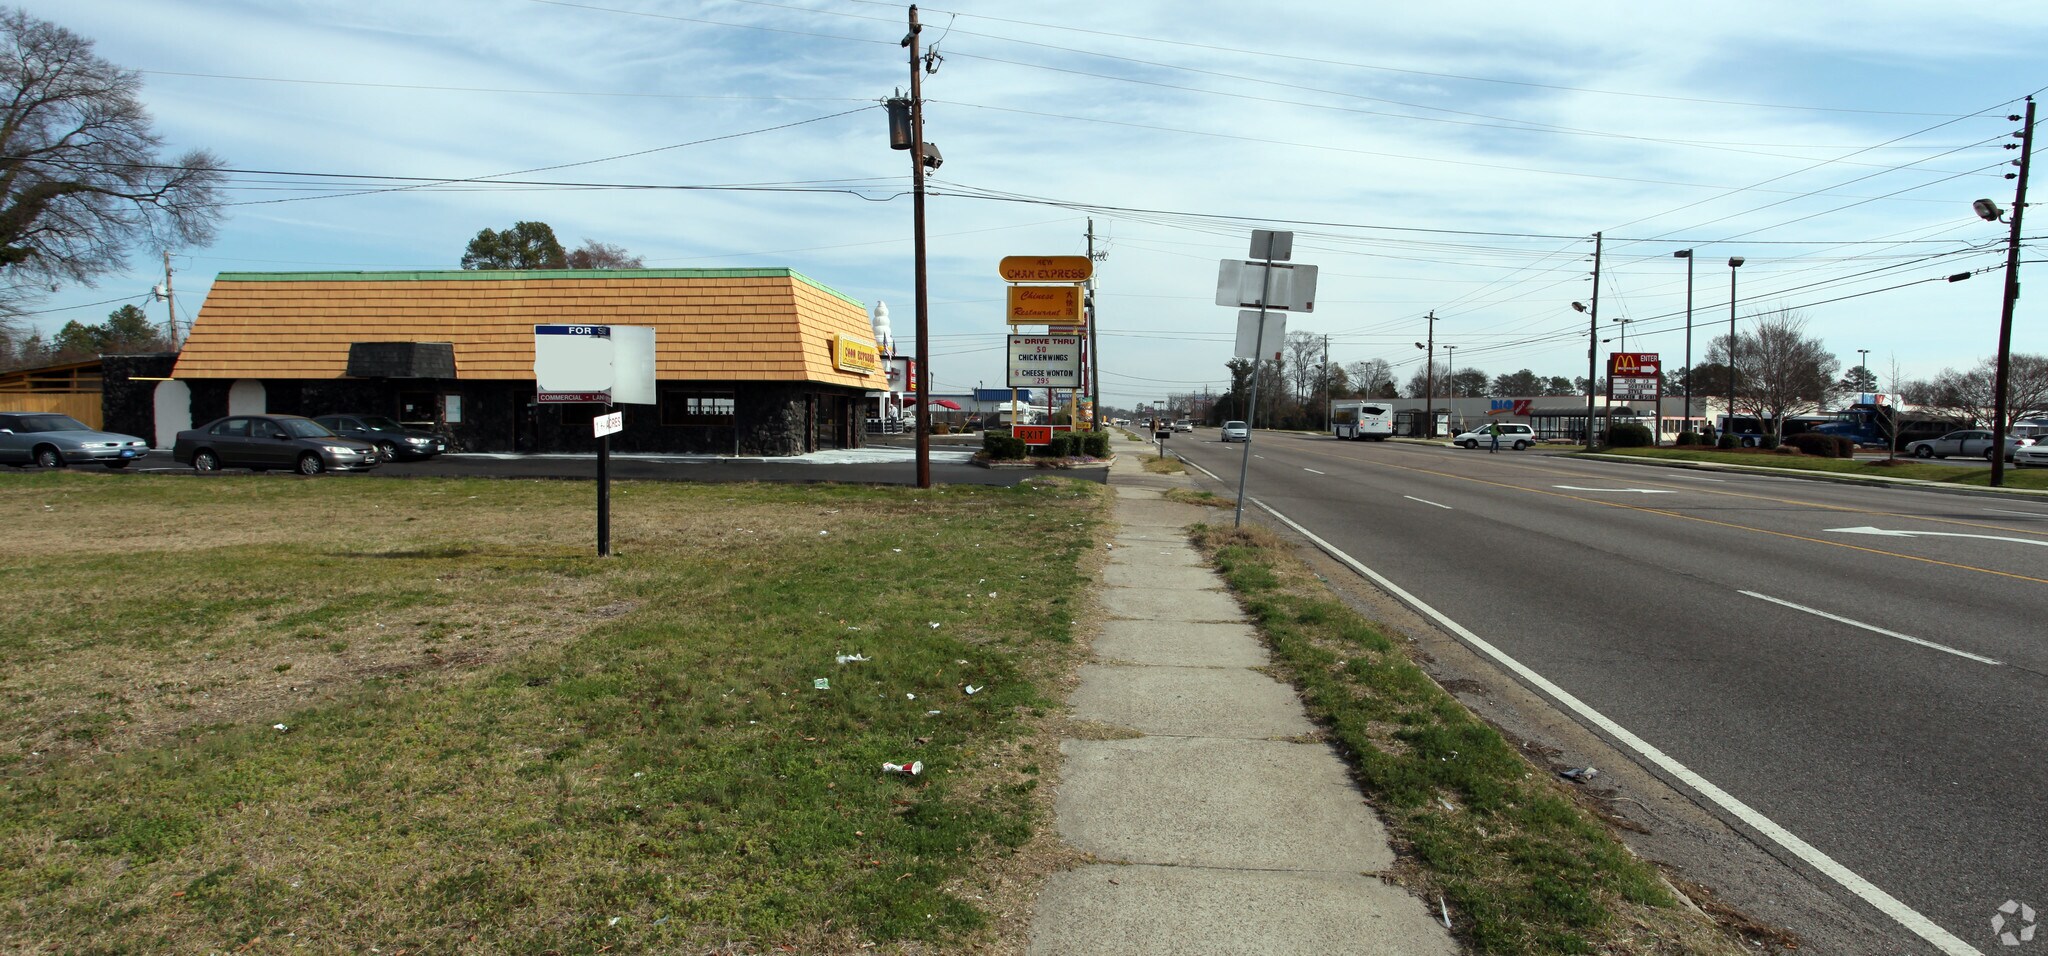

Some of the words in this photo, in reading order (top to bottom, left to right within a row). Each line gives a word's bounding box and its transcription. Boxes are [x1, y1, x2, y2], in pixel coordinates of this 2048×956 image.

[1007, 269, 1035, 279] CHAN
[1037, 269, 1086, 279] EXPRESS
[1020, 290, 1055, 301] Chinese
[1013, 306, 1061, 316] Restaurant
[568, 327, 591, 335] FOR
[1640, 354, 1658, 362] ENTER
[1020, 430, 1045, 440] EXIT
